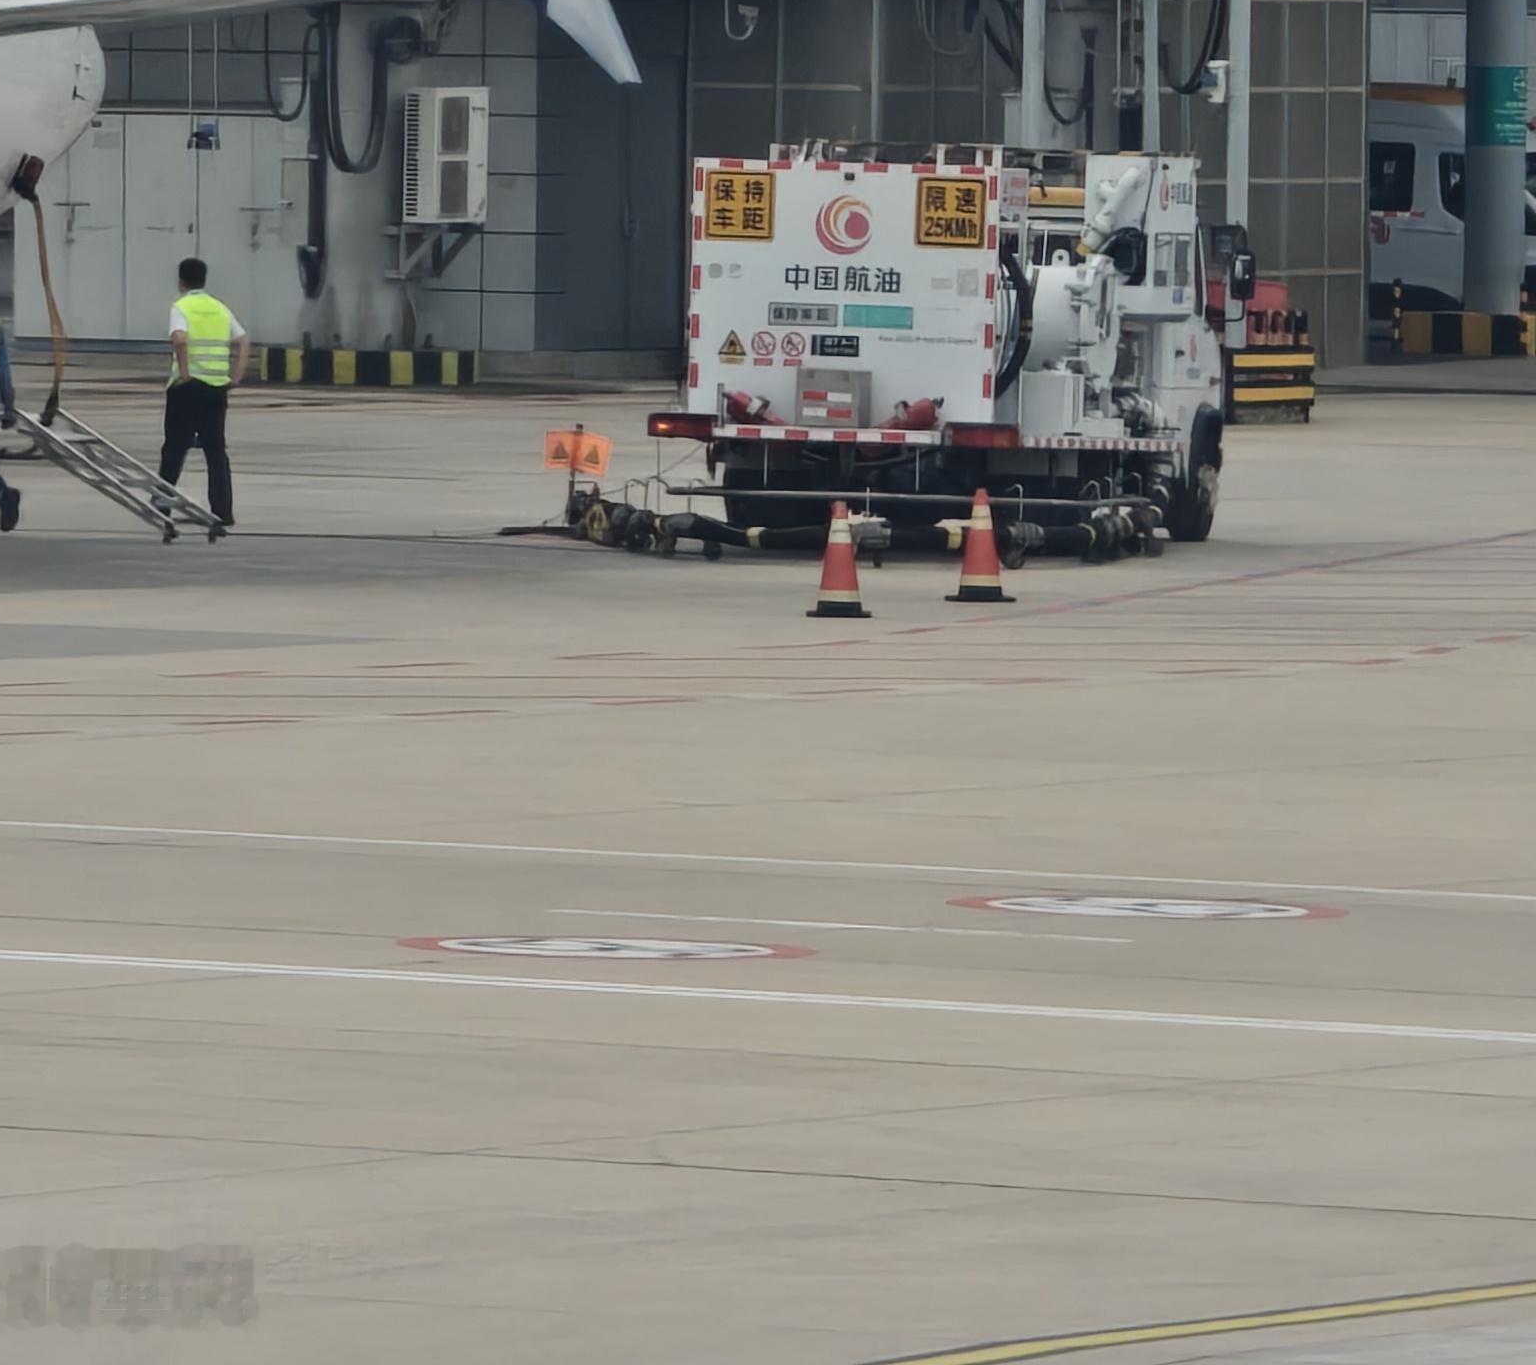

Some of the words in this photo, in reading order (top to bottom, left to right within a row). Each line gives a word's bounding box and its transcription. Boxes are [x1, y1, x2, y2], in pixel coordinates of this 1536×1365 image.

[713, 178, 767, 204] 保持
[712, 206, 766, 232] 车距
[784, 264, 901, 294] 中国航油
